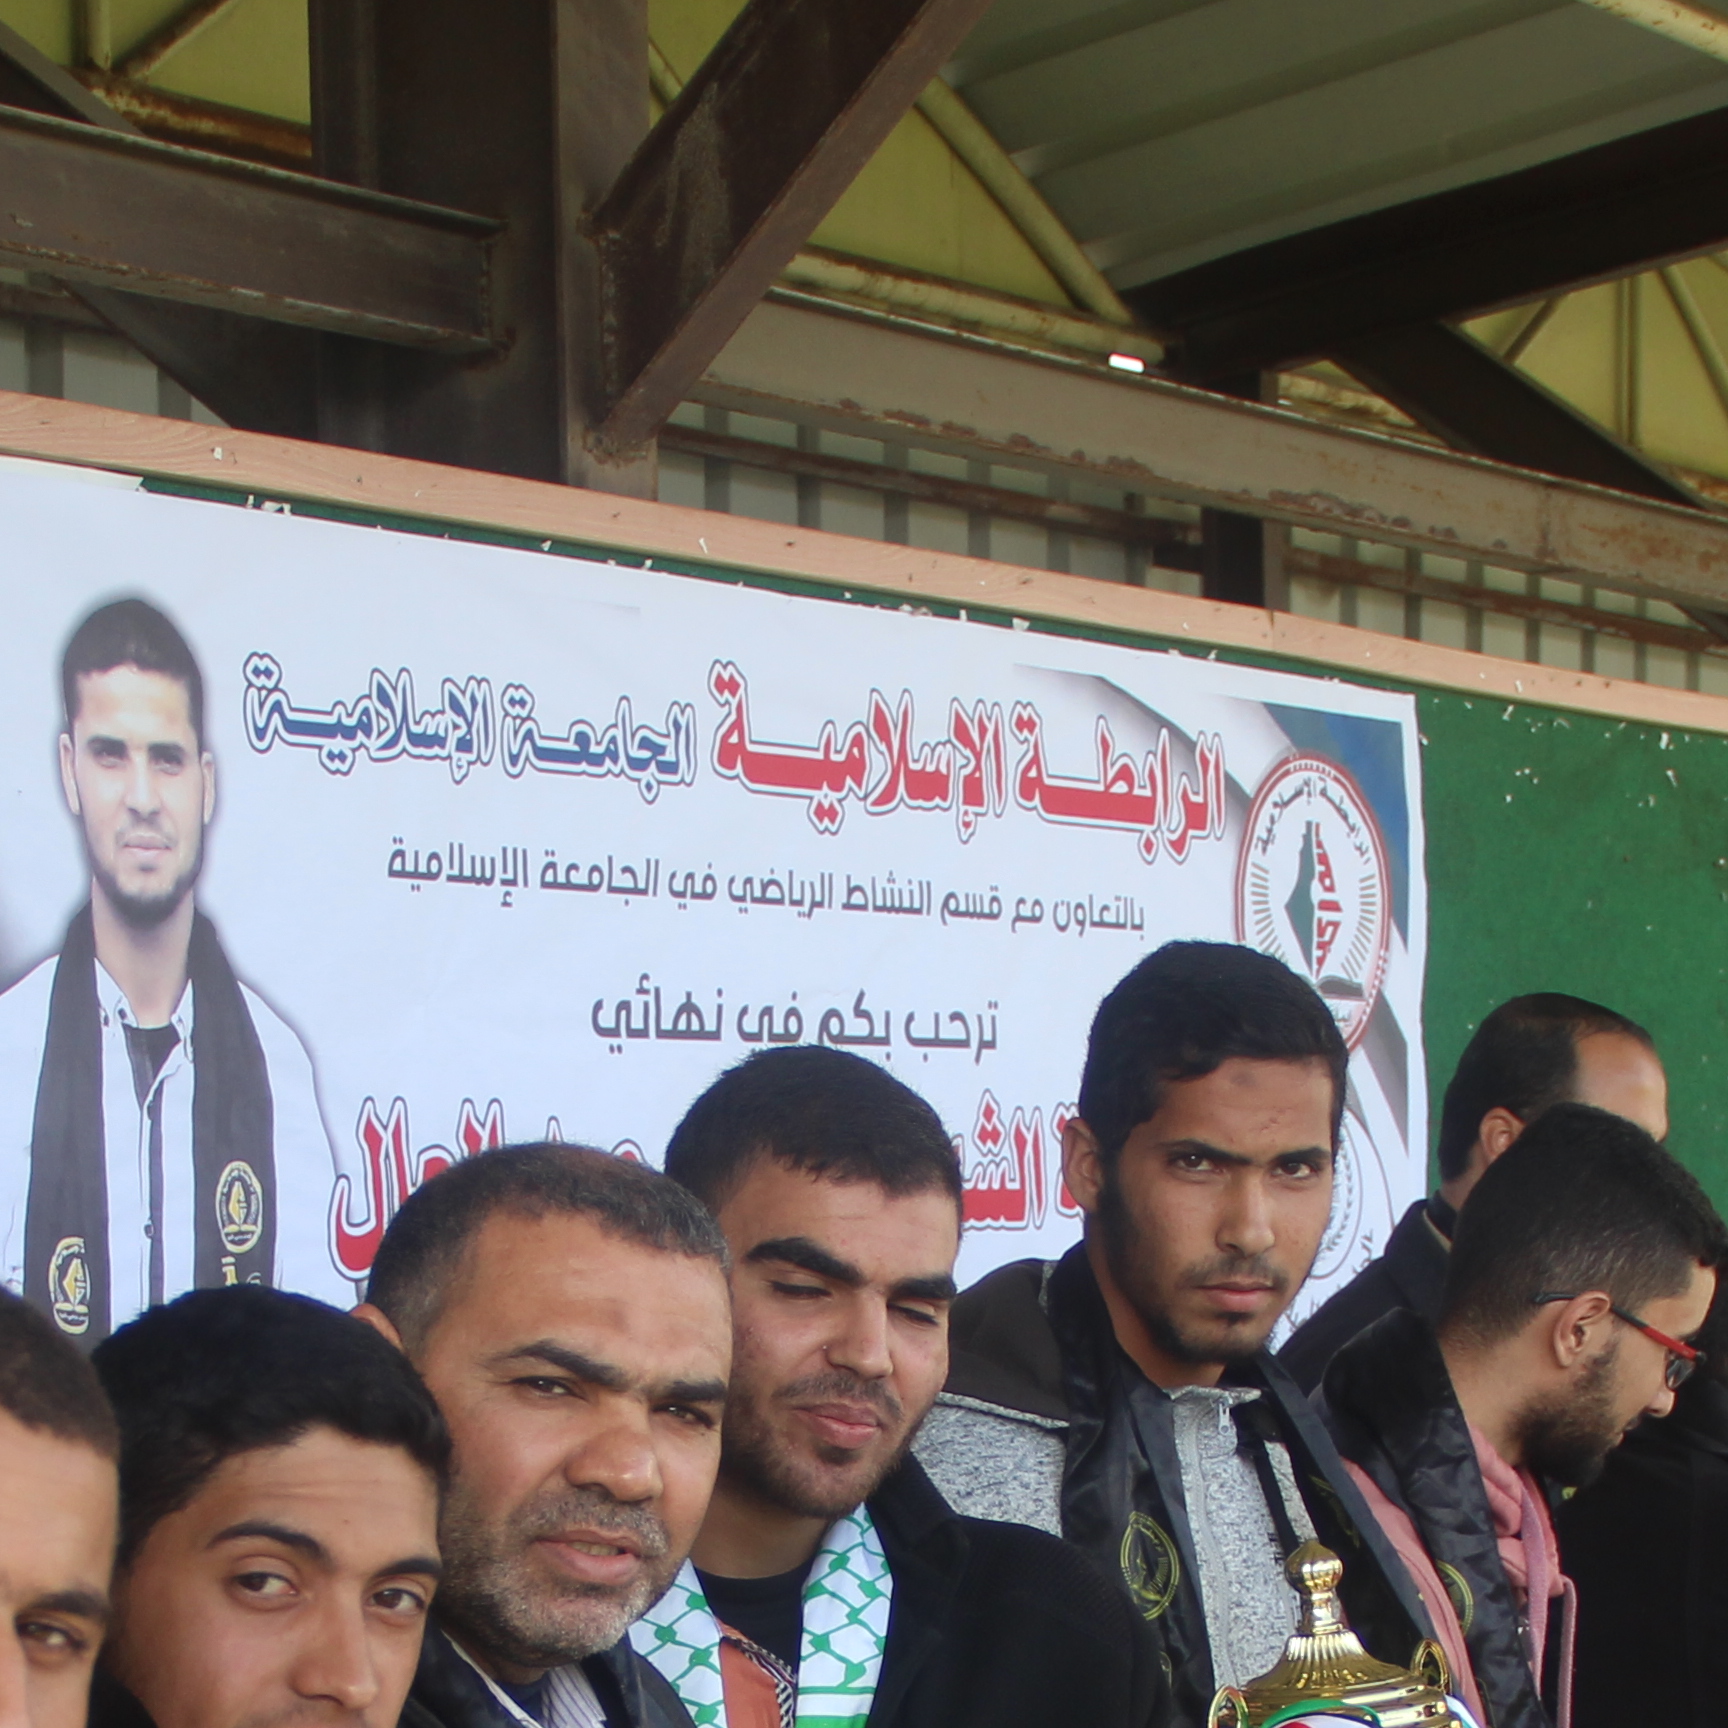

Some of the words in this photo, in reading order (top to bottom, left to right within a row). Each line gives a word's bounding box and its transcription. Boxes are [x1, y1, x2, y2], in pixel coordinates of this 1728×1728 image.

[243, 651, 494, 784] الإسلامية
[501, 683, 696, 804] الجامعة
[709, 658, 1007, 843] الإسلامية
[1010, 701, 1226, 865] الرابطة
[387, 835, 529, 908] الإسلامية
[539, 847, 660, 907] الجامعة
[668, 861, 718, 911] في
[727, 869, 834, 921] الرياضي
[841, 870, 932, 917] النشاط
[940, 886, 1002, 926] قسم
[1011, 898, 1045, 934] مع
[1052, 895, 1145, 941] بالتعاون
[590, 972, 724, 1055] نهائي
[736, 997, 803, 1050] في
[818, 990, 892, 1062] بكم
[904, 1001, 998, 1064] ترحب
